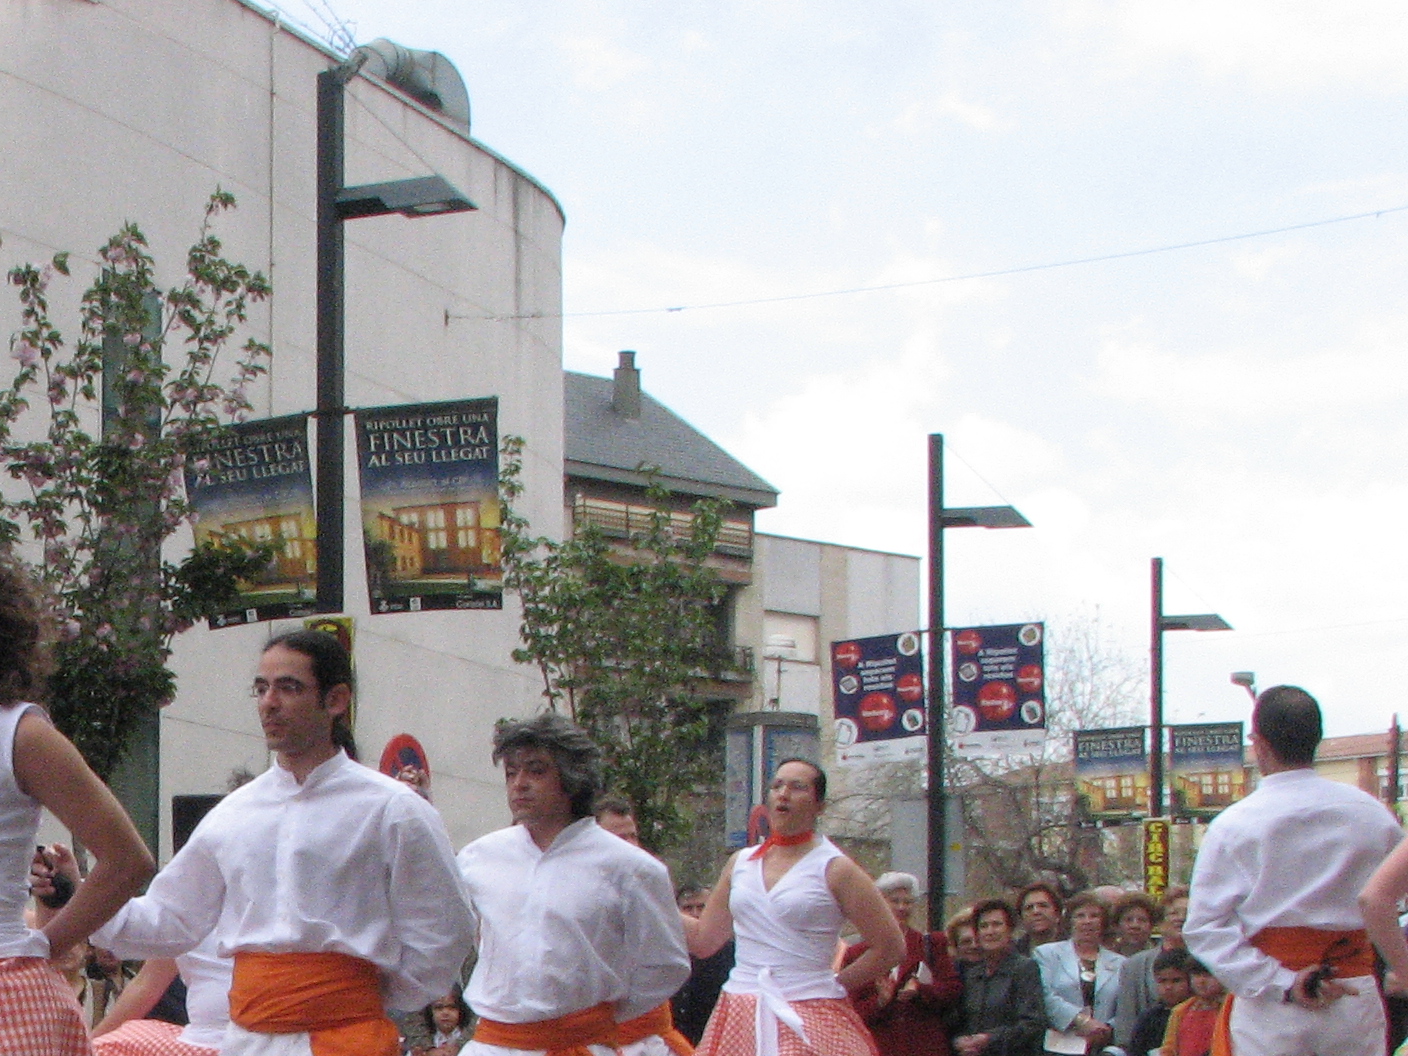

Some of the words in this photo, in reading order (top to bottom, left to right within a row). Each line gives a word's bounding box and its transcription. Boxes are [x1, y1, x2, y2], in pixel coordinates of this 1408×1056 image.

[365, 419, 423, 430] RIPOLLET
[462, 413, 490, 423] UNA
[369, 426, 490, 452] FINESTRA
[193, 441, 303, 470] NESTRA
[367, 453, 391, 468] AL
[395, 449, 426, 465] SEU
[432, 446, 490, 462] LLEGAT
[252, 460, 306, 479] LLEGAT
[1078, 738, 1141, 752] FINESTRA
[1175, 734, 1240, 747] FINESTRA
[1147, 865, 1164, 898] RAL
